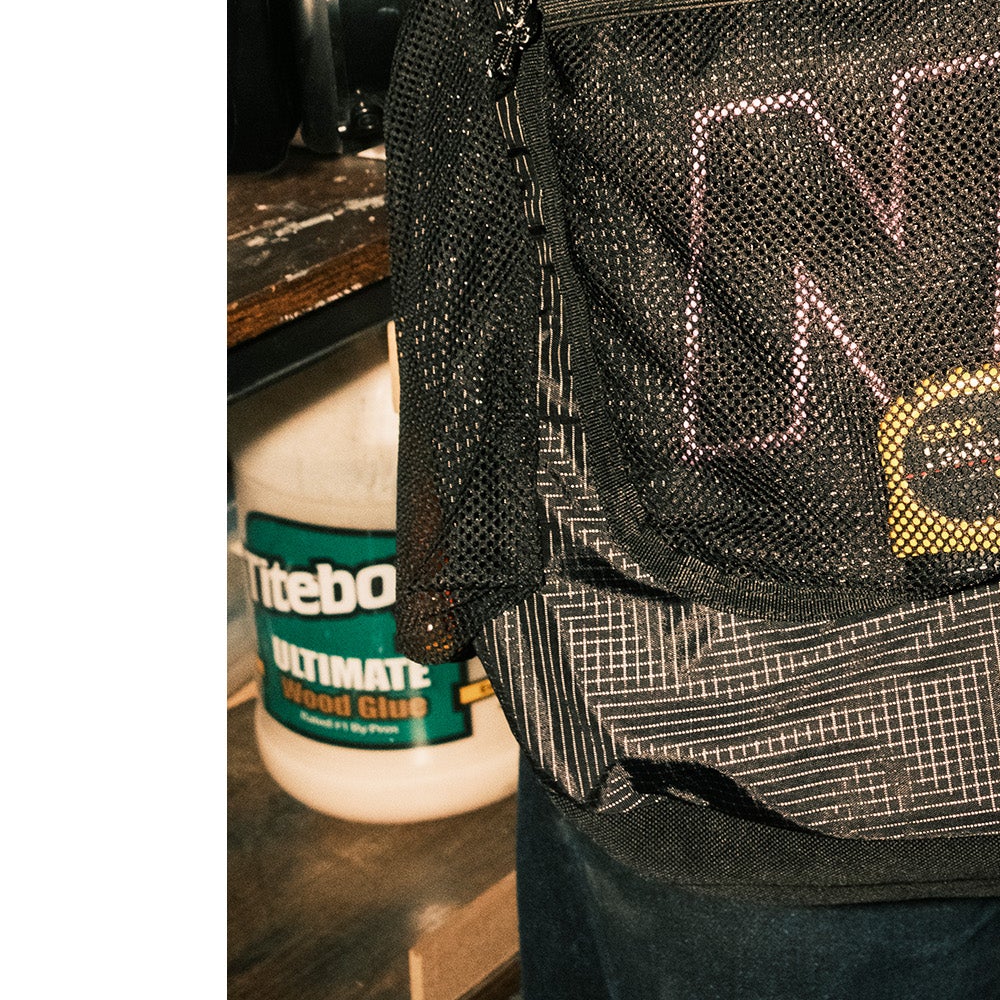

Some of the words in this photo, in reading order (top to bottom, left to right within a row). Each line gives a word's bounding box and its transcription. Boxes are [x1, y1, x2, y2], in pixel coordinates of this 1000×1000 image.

[246, 554, 397, 616] Titebo
[272, 634, 432, 692] ULTIMATE
[281, 676, 351, 717] Wood
[357, 695, 428, 720] Glue
